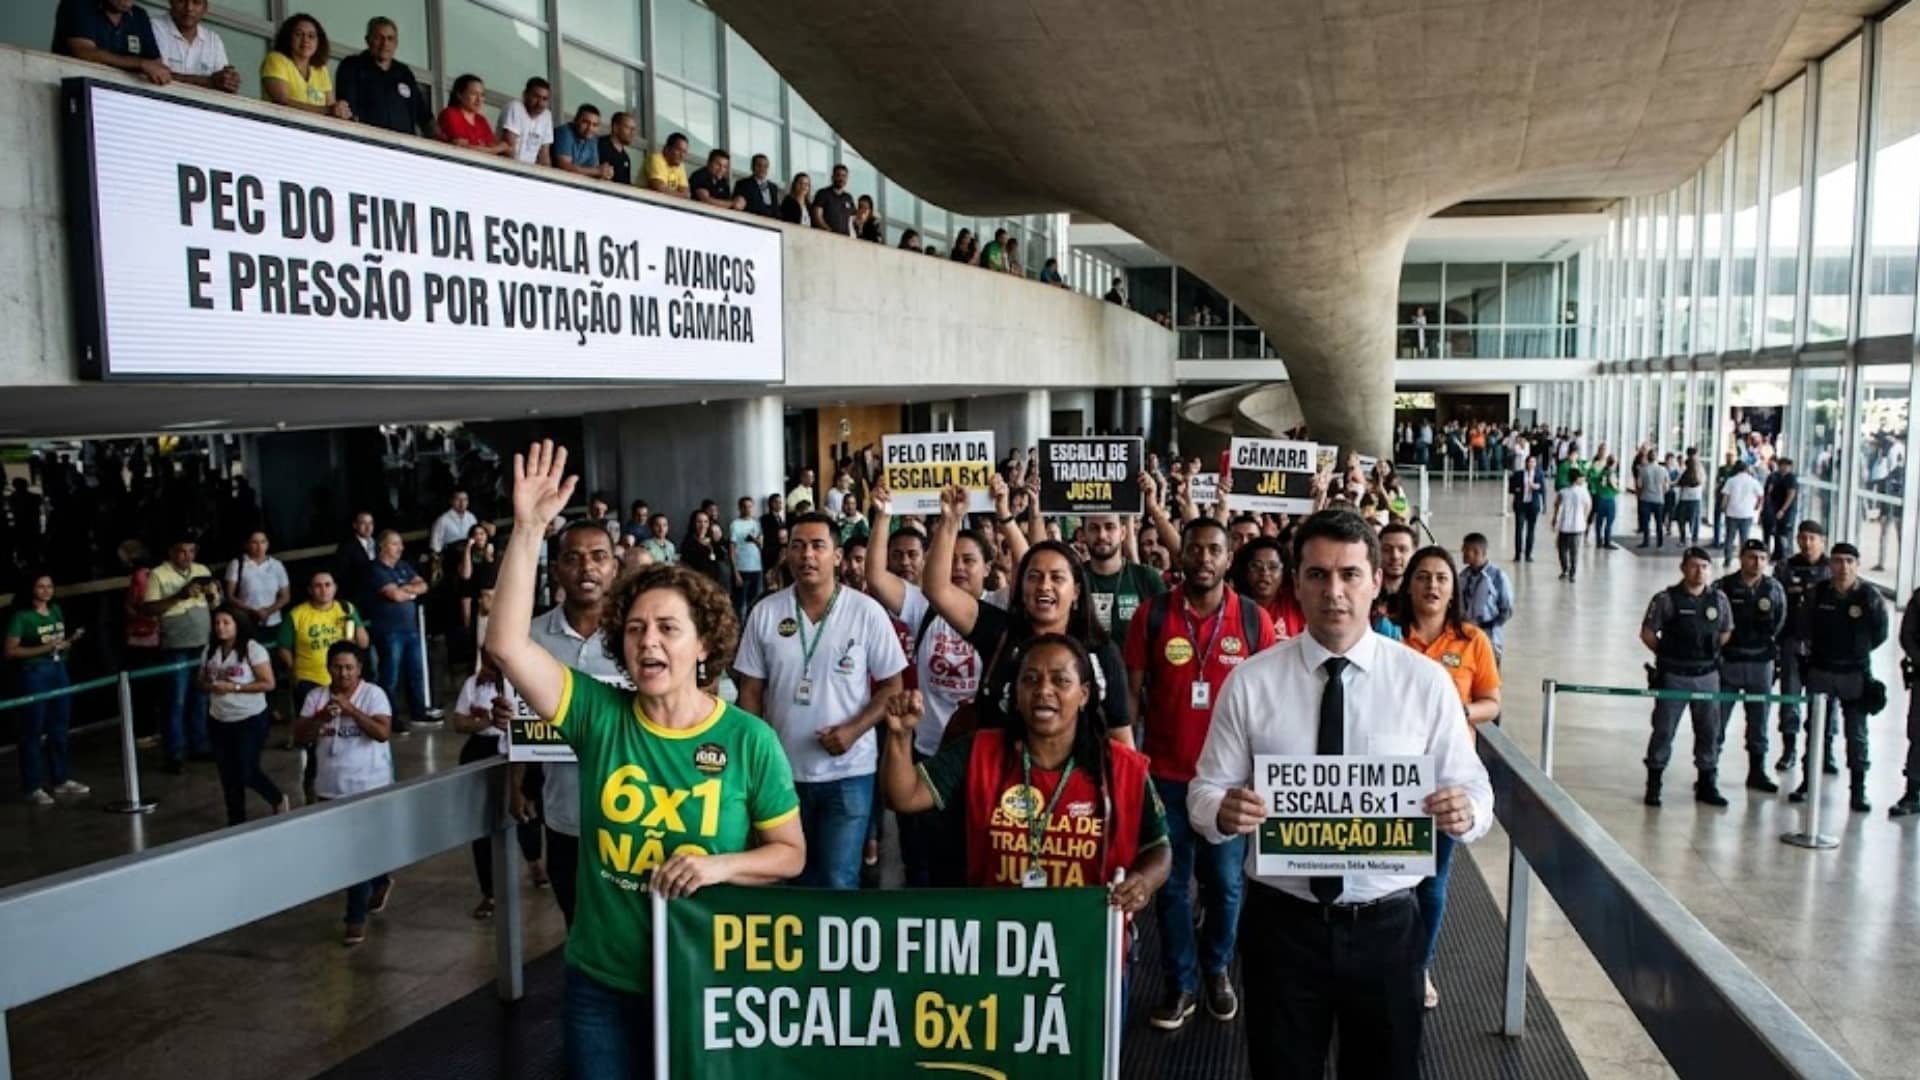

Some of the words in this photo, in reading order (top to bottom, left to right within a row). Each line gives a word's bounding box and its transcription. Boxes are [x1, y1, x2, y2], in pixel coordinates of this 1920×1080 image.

[177, 163, 266, 235] PEC
[279, 180, 335, 243] DO
[348, 191, 418, 254] FIM
[430, 206, 474, 262] DA
[484, 215, 590, 275] ESCALA
[599, 235, 640, 281] 6x1
[664, 246, 756, 301] AVANÇOS
[186, 246, 214, 310] E
[228, 251, 411, 322] PRESSÃO
[424, 272, 489, 327] POR
[499, 279, 621, 346] VOTAÇÃO
[630, 294, 660, 338] NA
[668, 290, 754, 344] CÂMARA
[888, 443, 925, 463] PELO
[932, 442, 961, 462] FIM
[966, 441, 988, 461] DA
[888, 466, 953, 489] ESCALA
[1066, 481, 1112, 500] JUSTA
[1257, 469, 1286, 494] JÁ!
[1267, 763, 1306, 787] PEC
[1313, 763, 1340, 787] DO
[1348, 763, 1385, 787] FIM
[1392, 763, 1421, 787] DA
[601, 764, 722, 837] 6x1
[1273, 791, 1353, 814] ESCALA
[1360, 791, 1398, 814] 6x1
[1075, 816, 1103, 837] DE
[1279, 819, 1377, 851] VOTAÇÃO
[1382, 818, 1414, 846] JÁ!
[598, 828, 709, 875] NÃ
[990, 830, 1097, 859] TRAALHO
[995, 855, 1085, 887] JUTA
[713, 914, 803, 971] PEC
[818, 915, 881, 973] DO
[897, 917, 981, 976] FIM
[996, 920, 1060, 978] DA
[704, 986, 901, 1050] ESCALA
[915, 991, 998, 1051] 6x1
[1013, 983, 1072, 1055] JÁ
